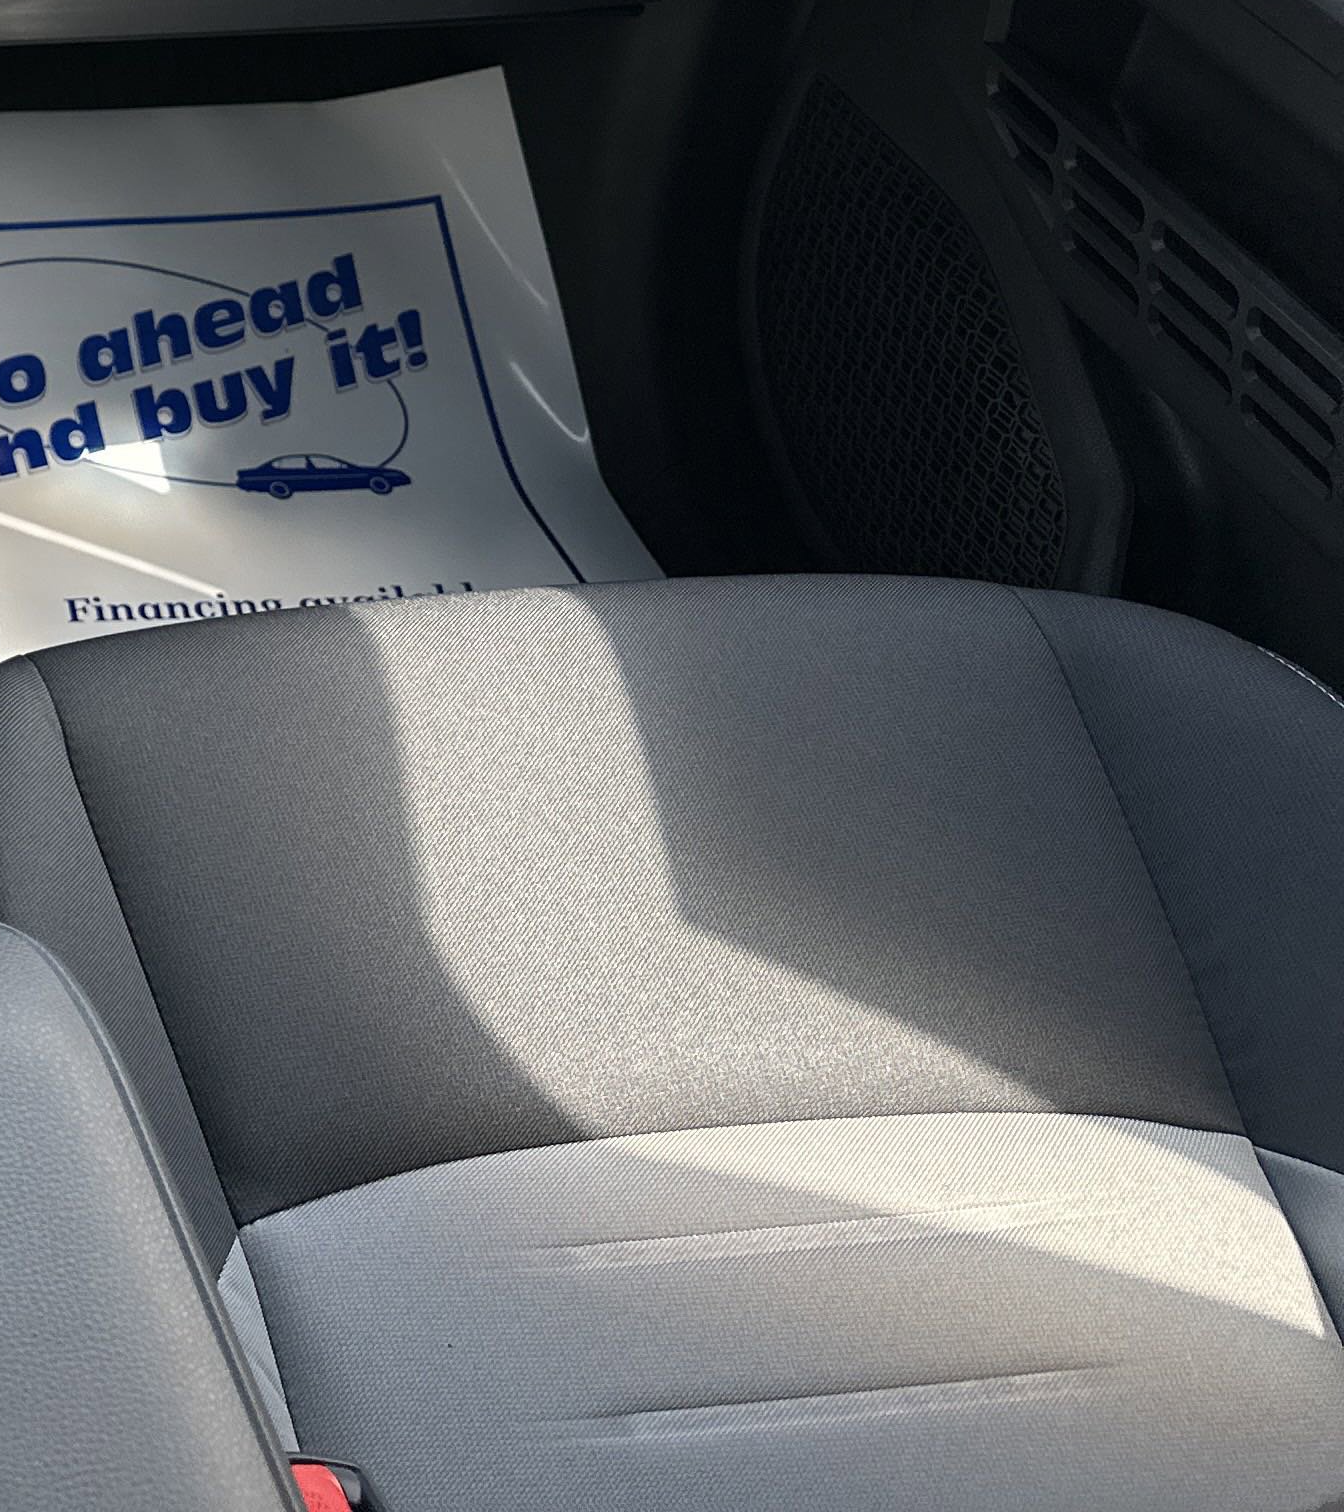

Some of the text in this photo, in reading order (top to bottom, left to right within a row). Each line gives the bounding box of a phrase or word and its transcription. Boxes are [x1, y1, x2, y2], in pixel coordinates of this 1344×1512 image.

[78, 252, 363, 384] ahead
[132, 354, 297, 443] buy
[327, 308, 429, 393] it!
